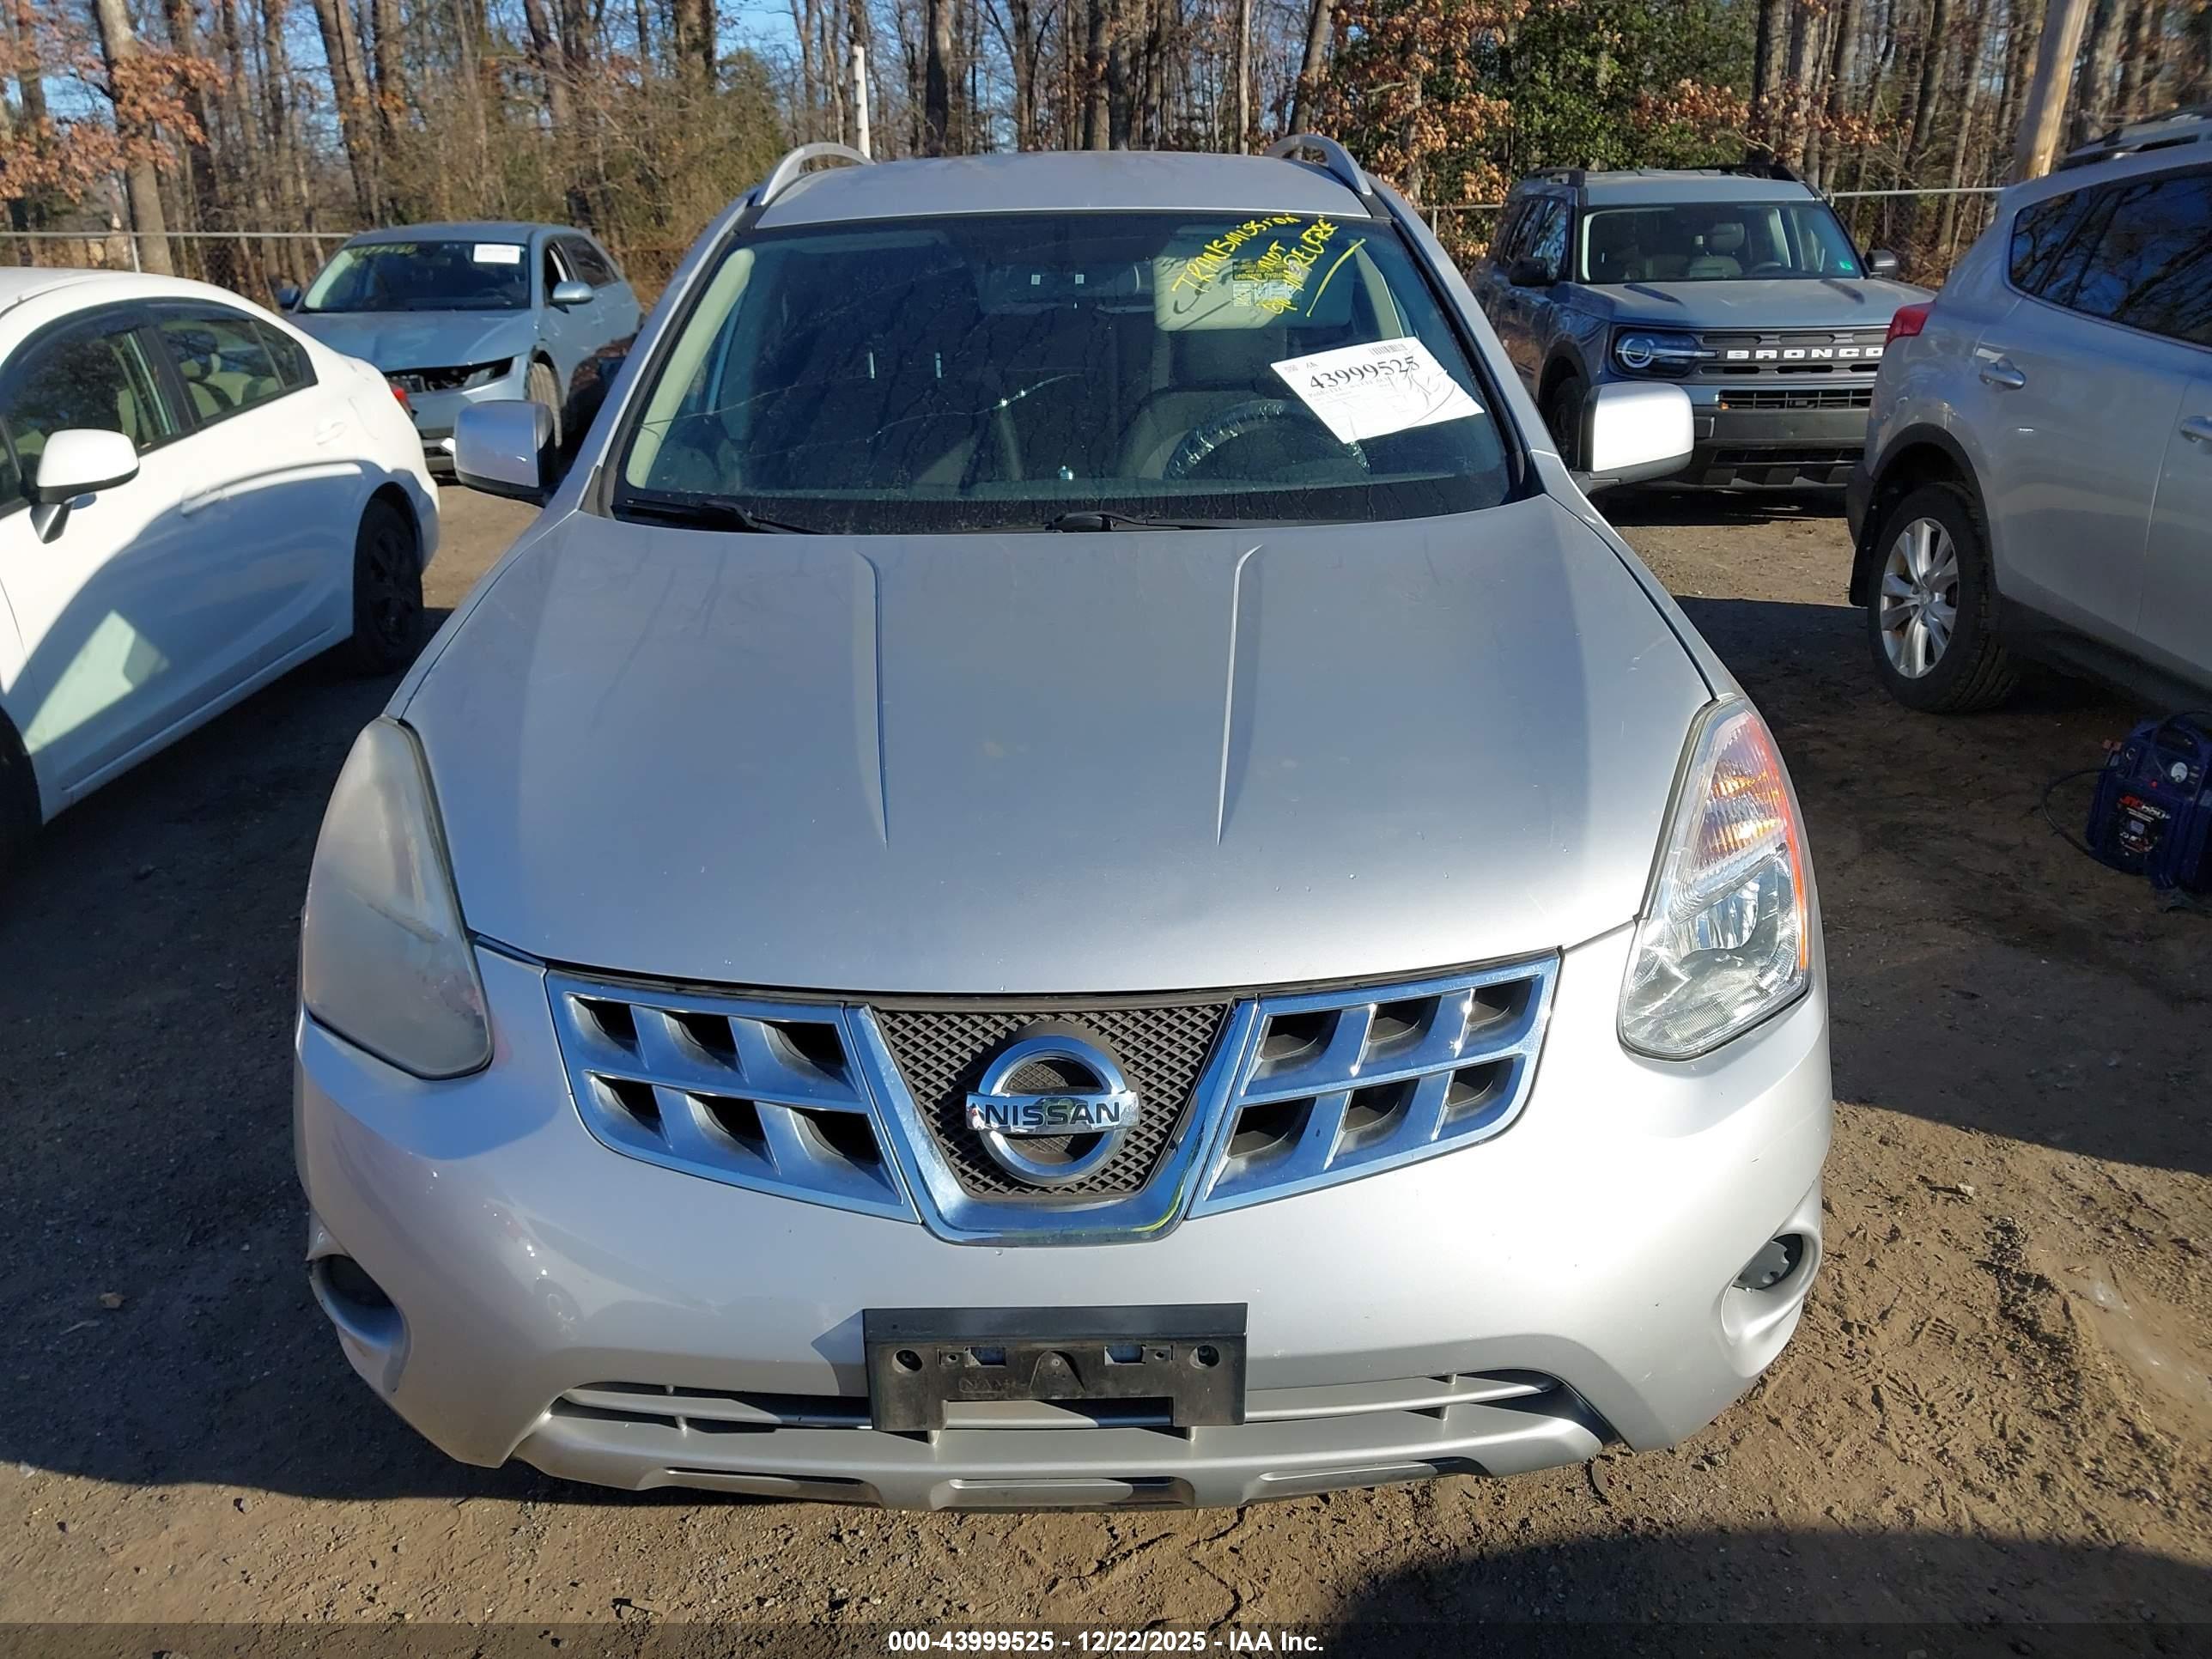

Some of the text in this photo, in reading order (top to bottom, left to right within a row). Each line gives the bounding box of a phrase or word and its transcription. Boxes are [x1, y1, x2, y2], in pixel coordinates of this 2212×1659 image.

[1727, 346, 1884, 359] BRONCO
[1310, 356, 1420, 389] 43999525
[984, 1101, 1120, 1127] NISSAN
